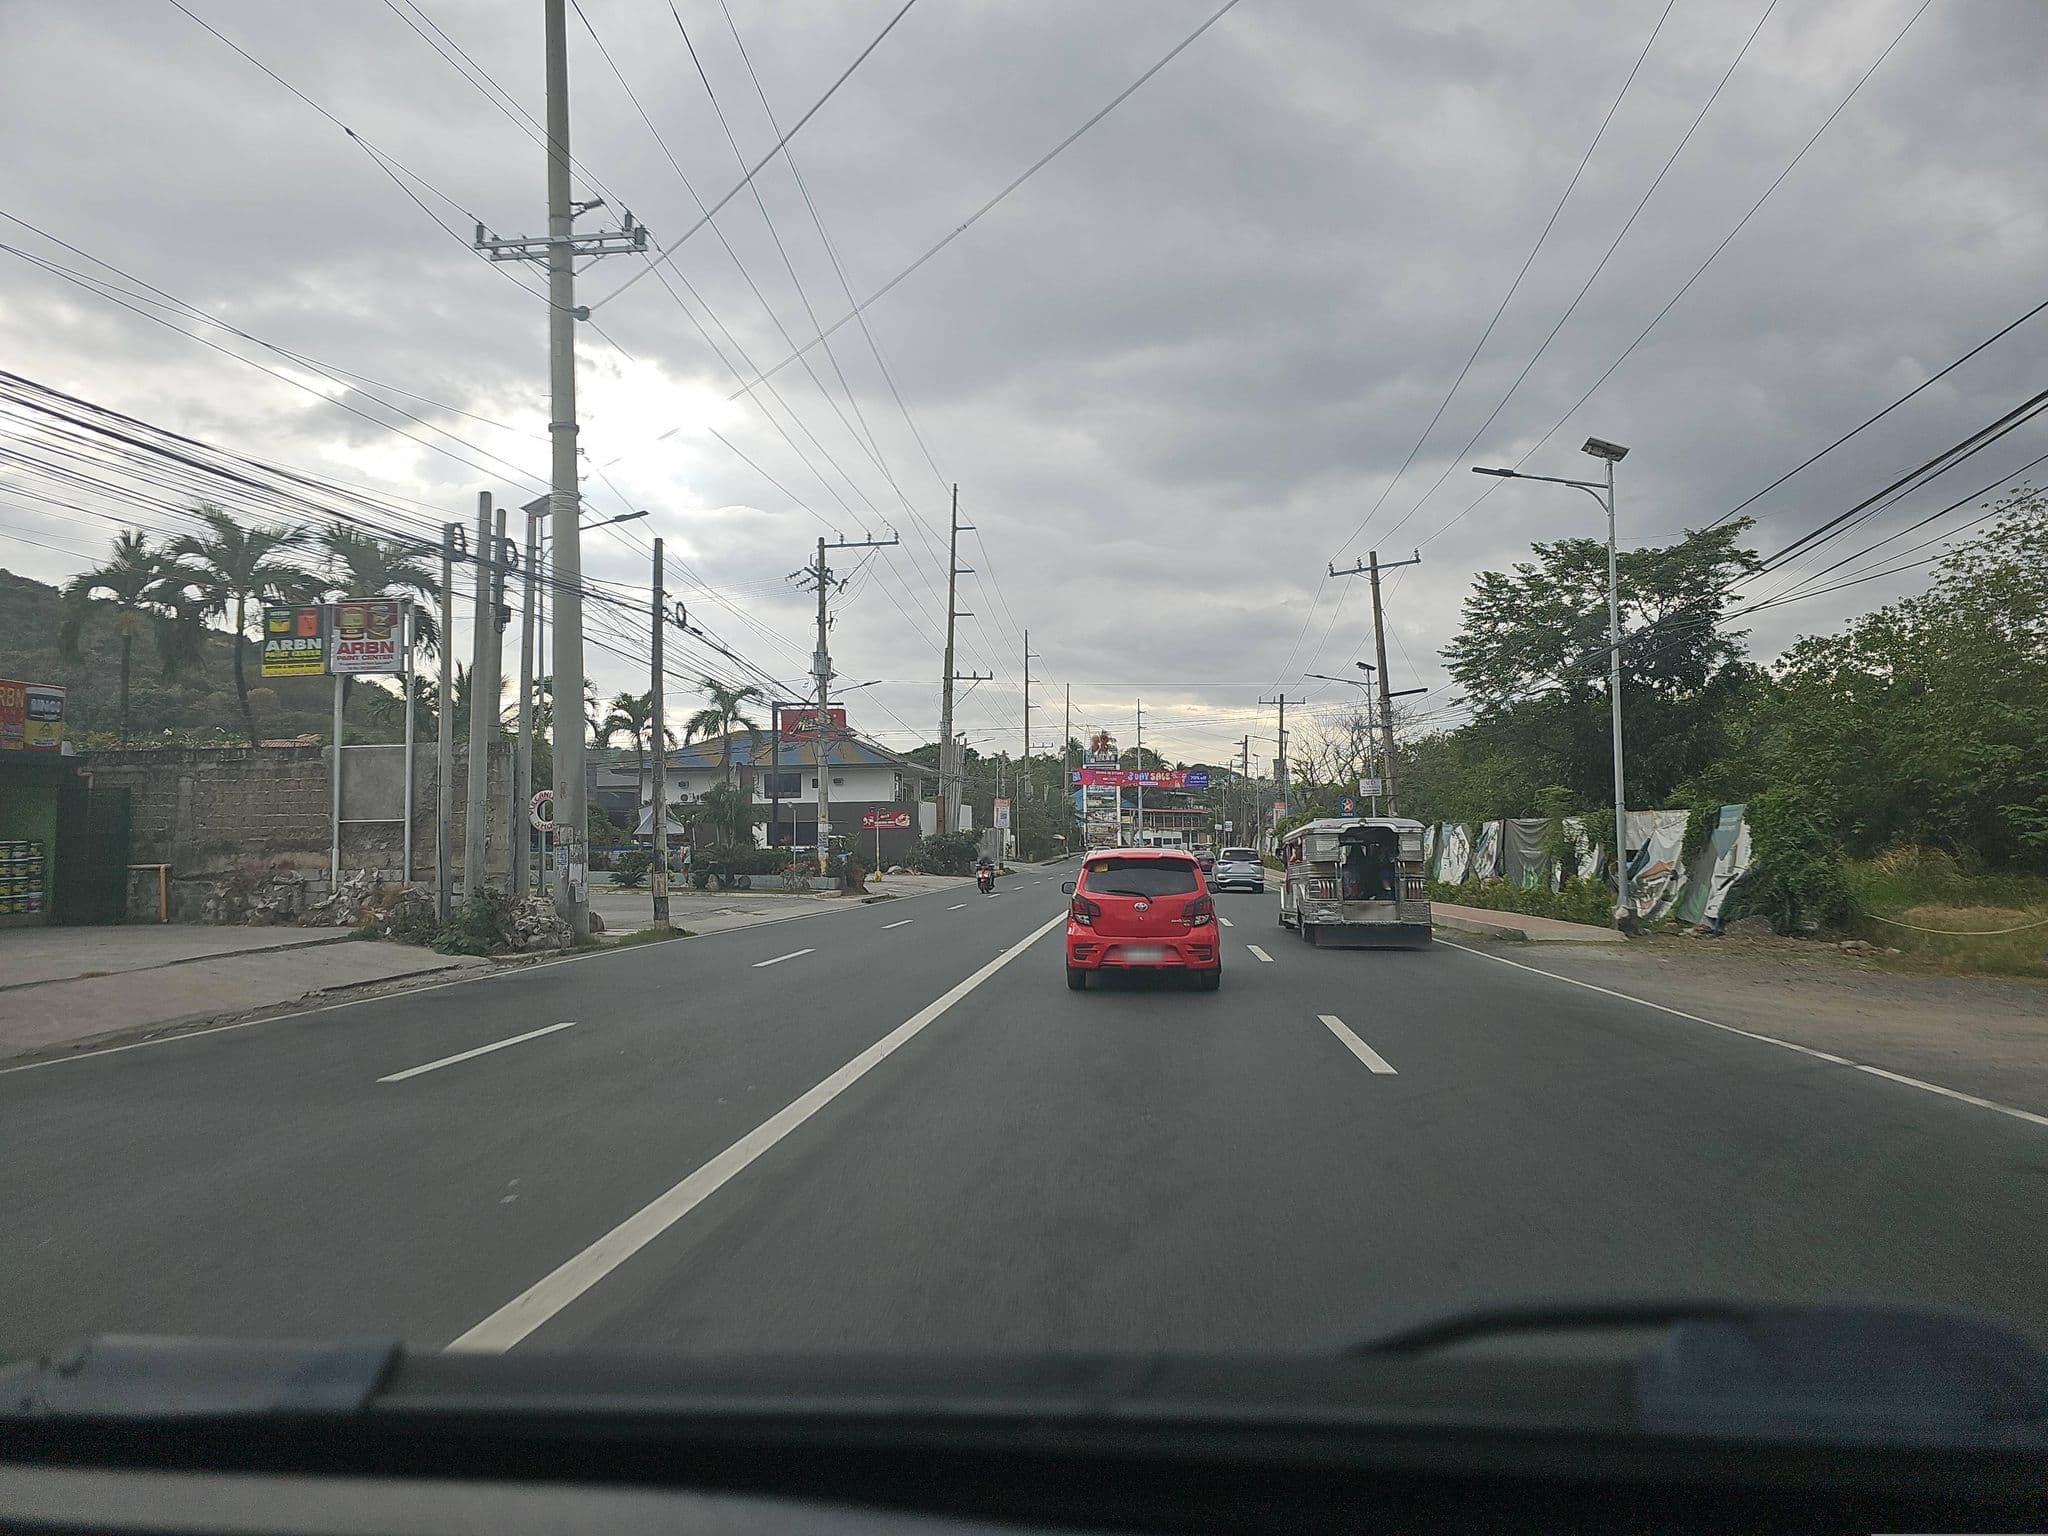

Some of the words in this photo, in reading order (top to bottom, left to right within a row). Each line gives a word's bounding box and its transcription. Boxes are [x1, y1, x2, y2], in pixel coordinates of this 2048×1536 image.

[265, 639, 322, 652] ARBN
[337, 641, 394, 654] ARBN
[1127, 772, 1134, 781] 3
[1134, 772, 1149, 781] DAY
[1150, 772, 1171, 781] SALE
[528, 791, 554, 816] VULCANI
[534, 821, 555, 830] SHO
